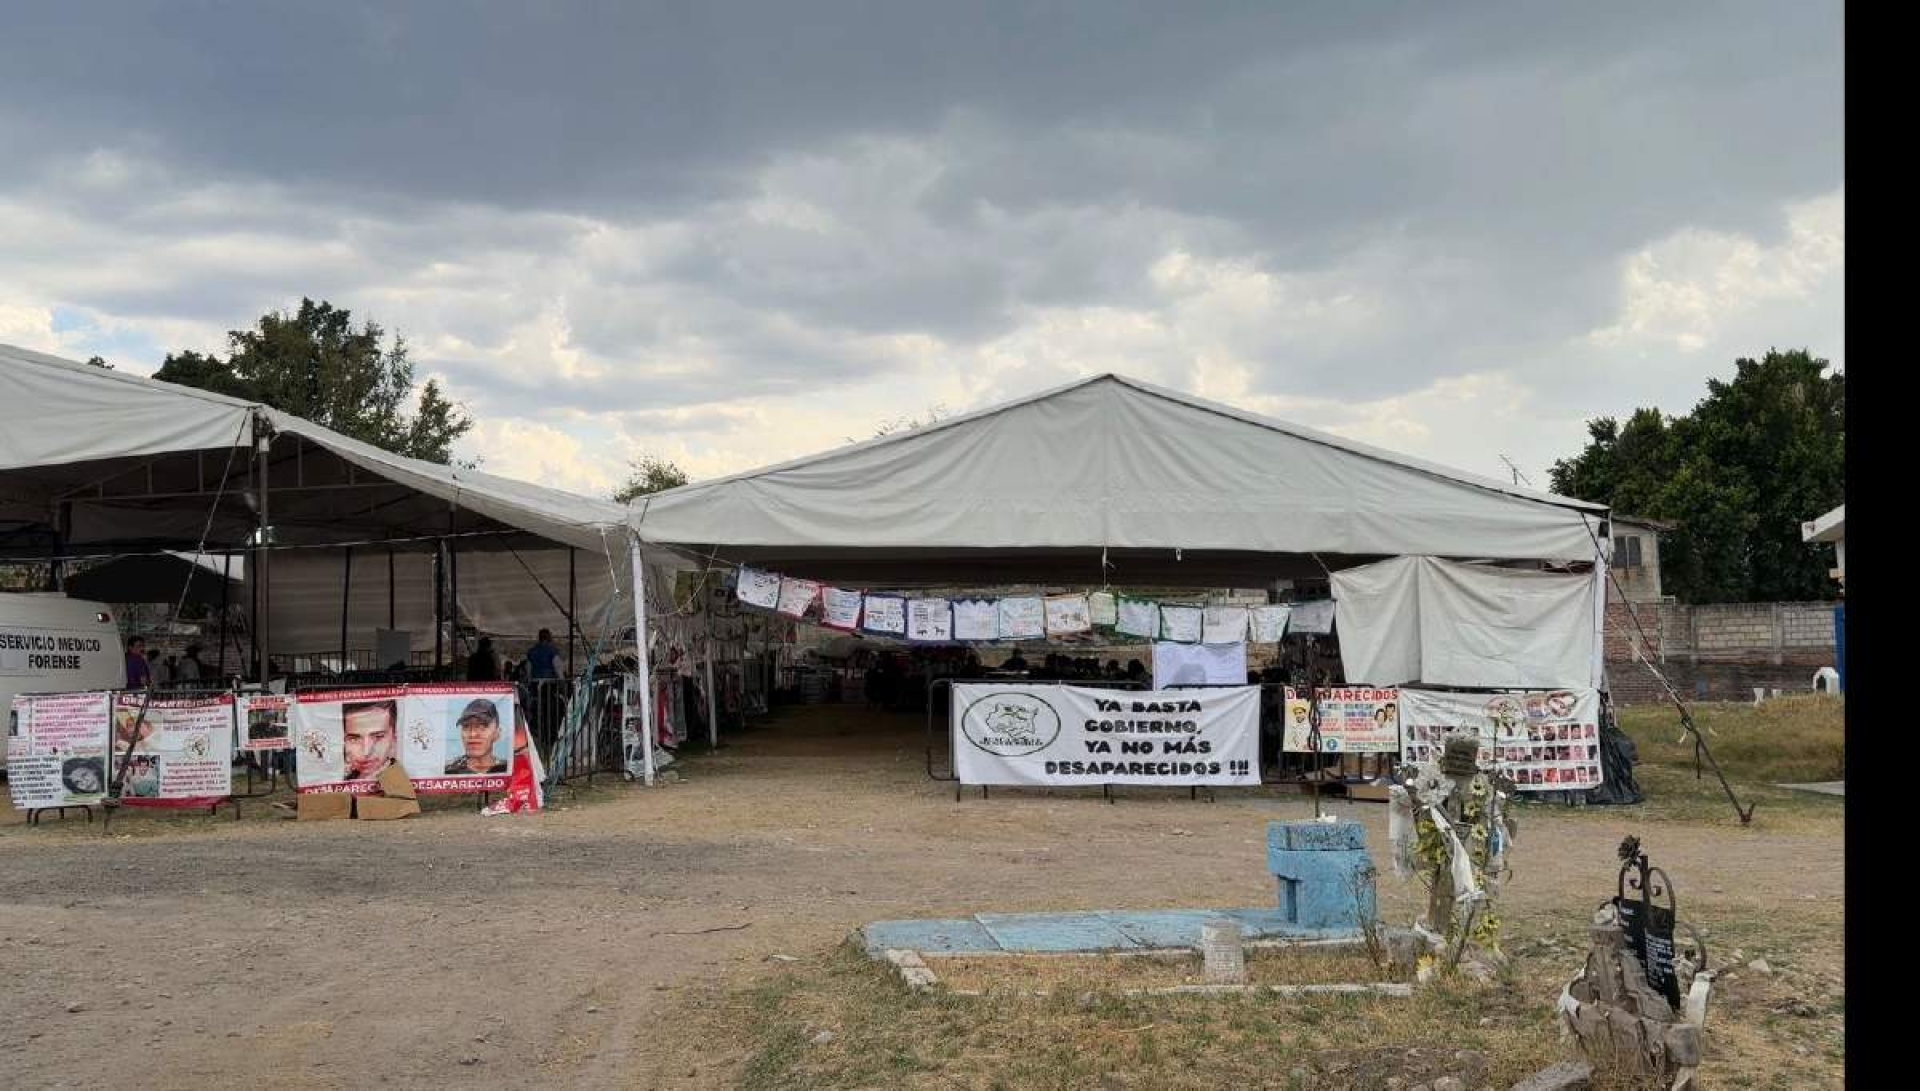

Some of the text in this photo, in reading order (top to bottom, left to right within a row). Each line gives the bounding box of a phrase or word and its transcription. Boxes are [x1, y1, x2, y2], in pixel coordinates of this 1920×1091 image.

[0, 635, 101, 652] SERVICIO MEDICO
[28, 654, 81, 669] FORENSE
[122, 694, 220, 708] DESPARECIDOS
[1287, 688, 1398, 701] DARECIDOS
[1094, 699, 1202, 713] YA BASTA
[1084, 719, 1203, 735] GOBIERNO,
[1084, 736, 1212, 755] YA NO MÁS
[1044, 761, 1222, 776] DESAPARECIDOS
[305, 783, 384, 794] DESAPAREC
[410, 779, 505, 790] DESAPARECIDO
